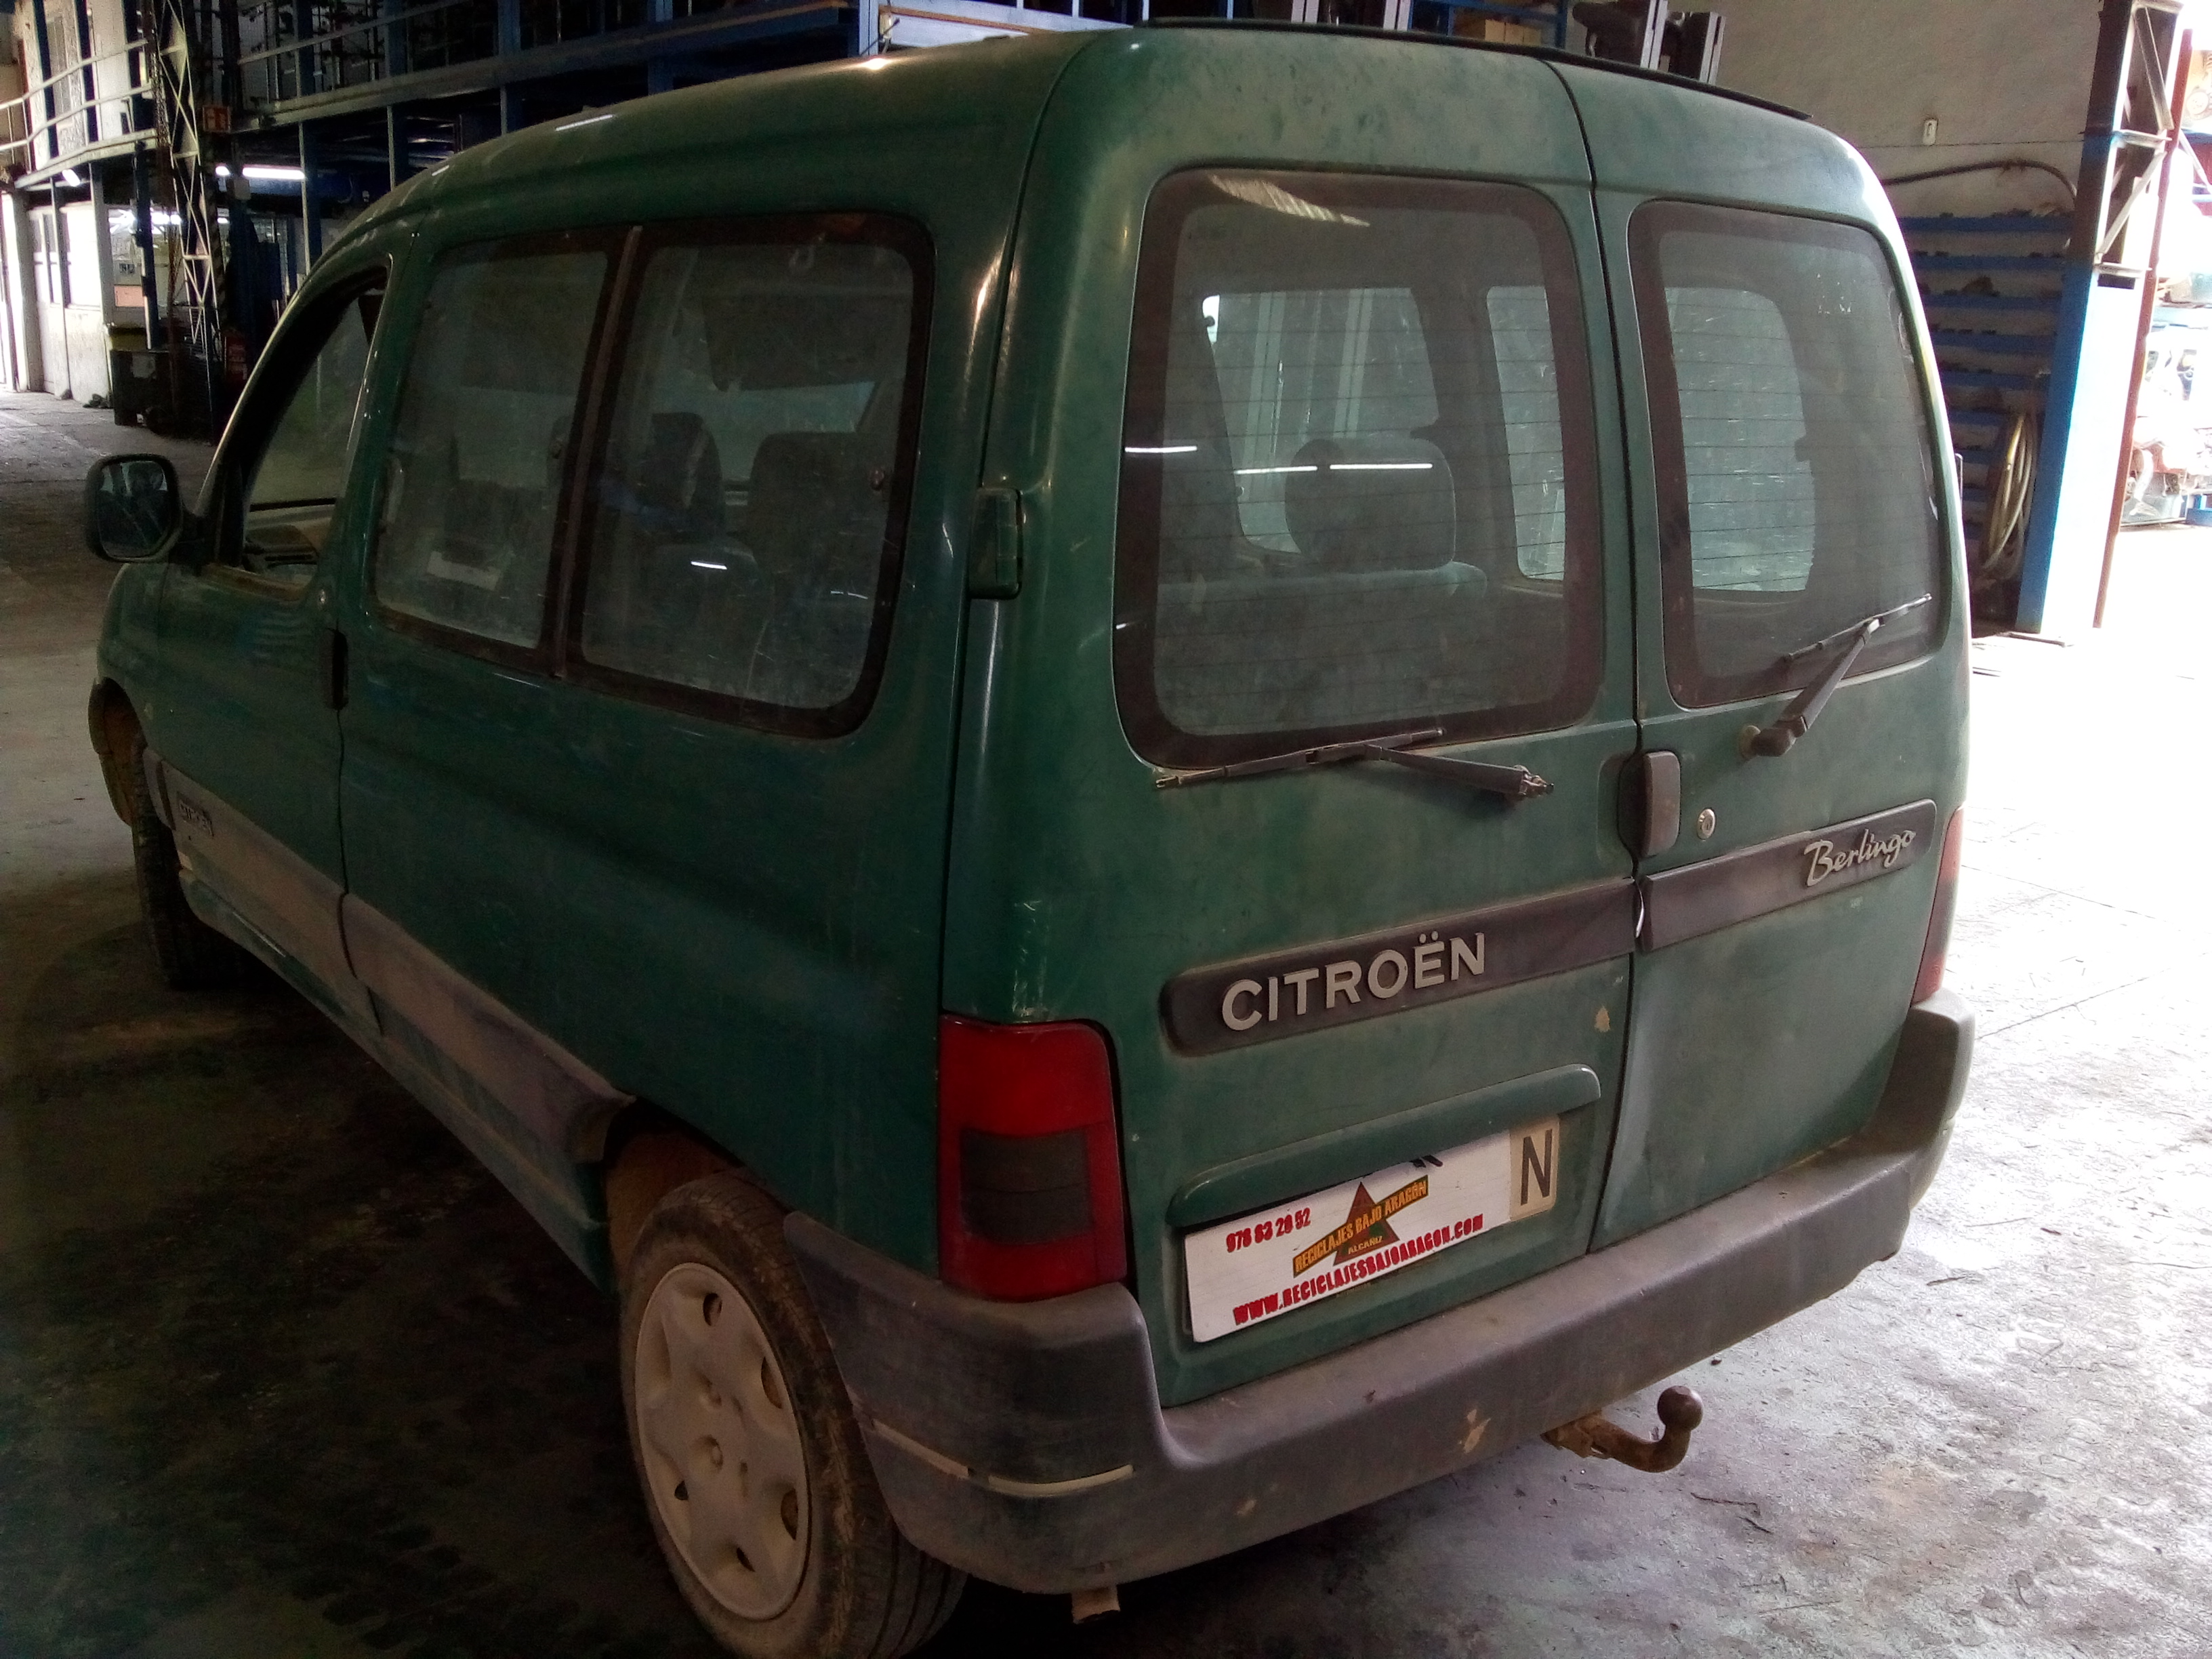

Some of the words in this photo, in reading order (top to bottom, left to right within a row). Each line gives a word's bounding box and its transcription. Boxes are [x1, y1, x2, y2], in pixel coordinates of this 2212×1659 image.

[1804, 828, 1917, 887] Berlingo
[1221, 930, 1486, 1031] CITROËN
[1520, 1129, 1553, 1206] N
[1275, 1214, 1294, 1237] 20
[1294, 1207, 1312, 1229] 52
[1295, 1222, 1355, 1272] RECICLAJES
[1355, 1204, 1382, 1233] BAJO
[1233, 1213, 1484, 1326] WWW.RECICLAJESBAJOARAGON.COM
